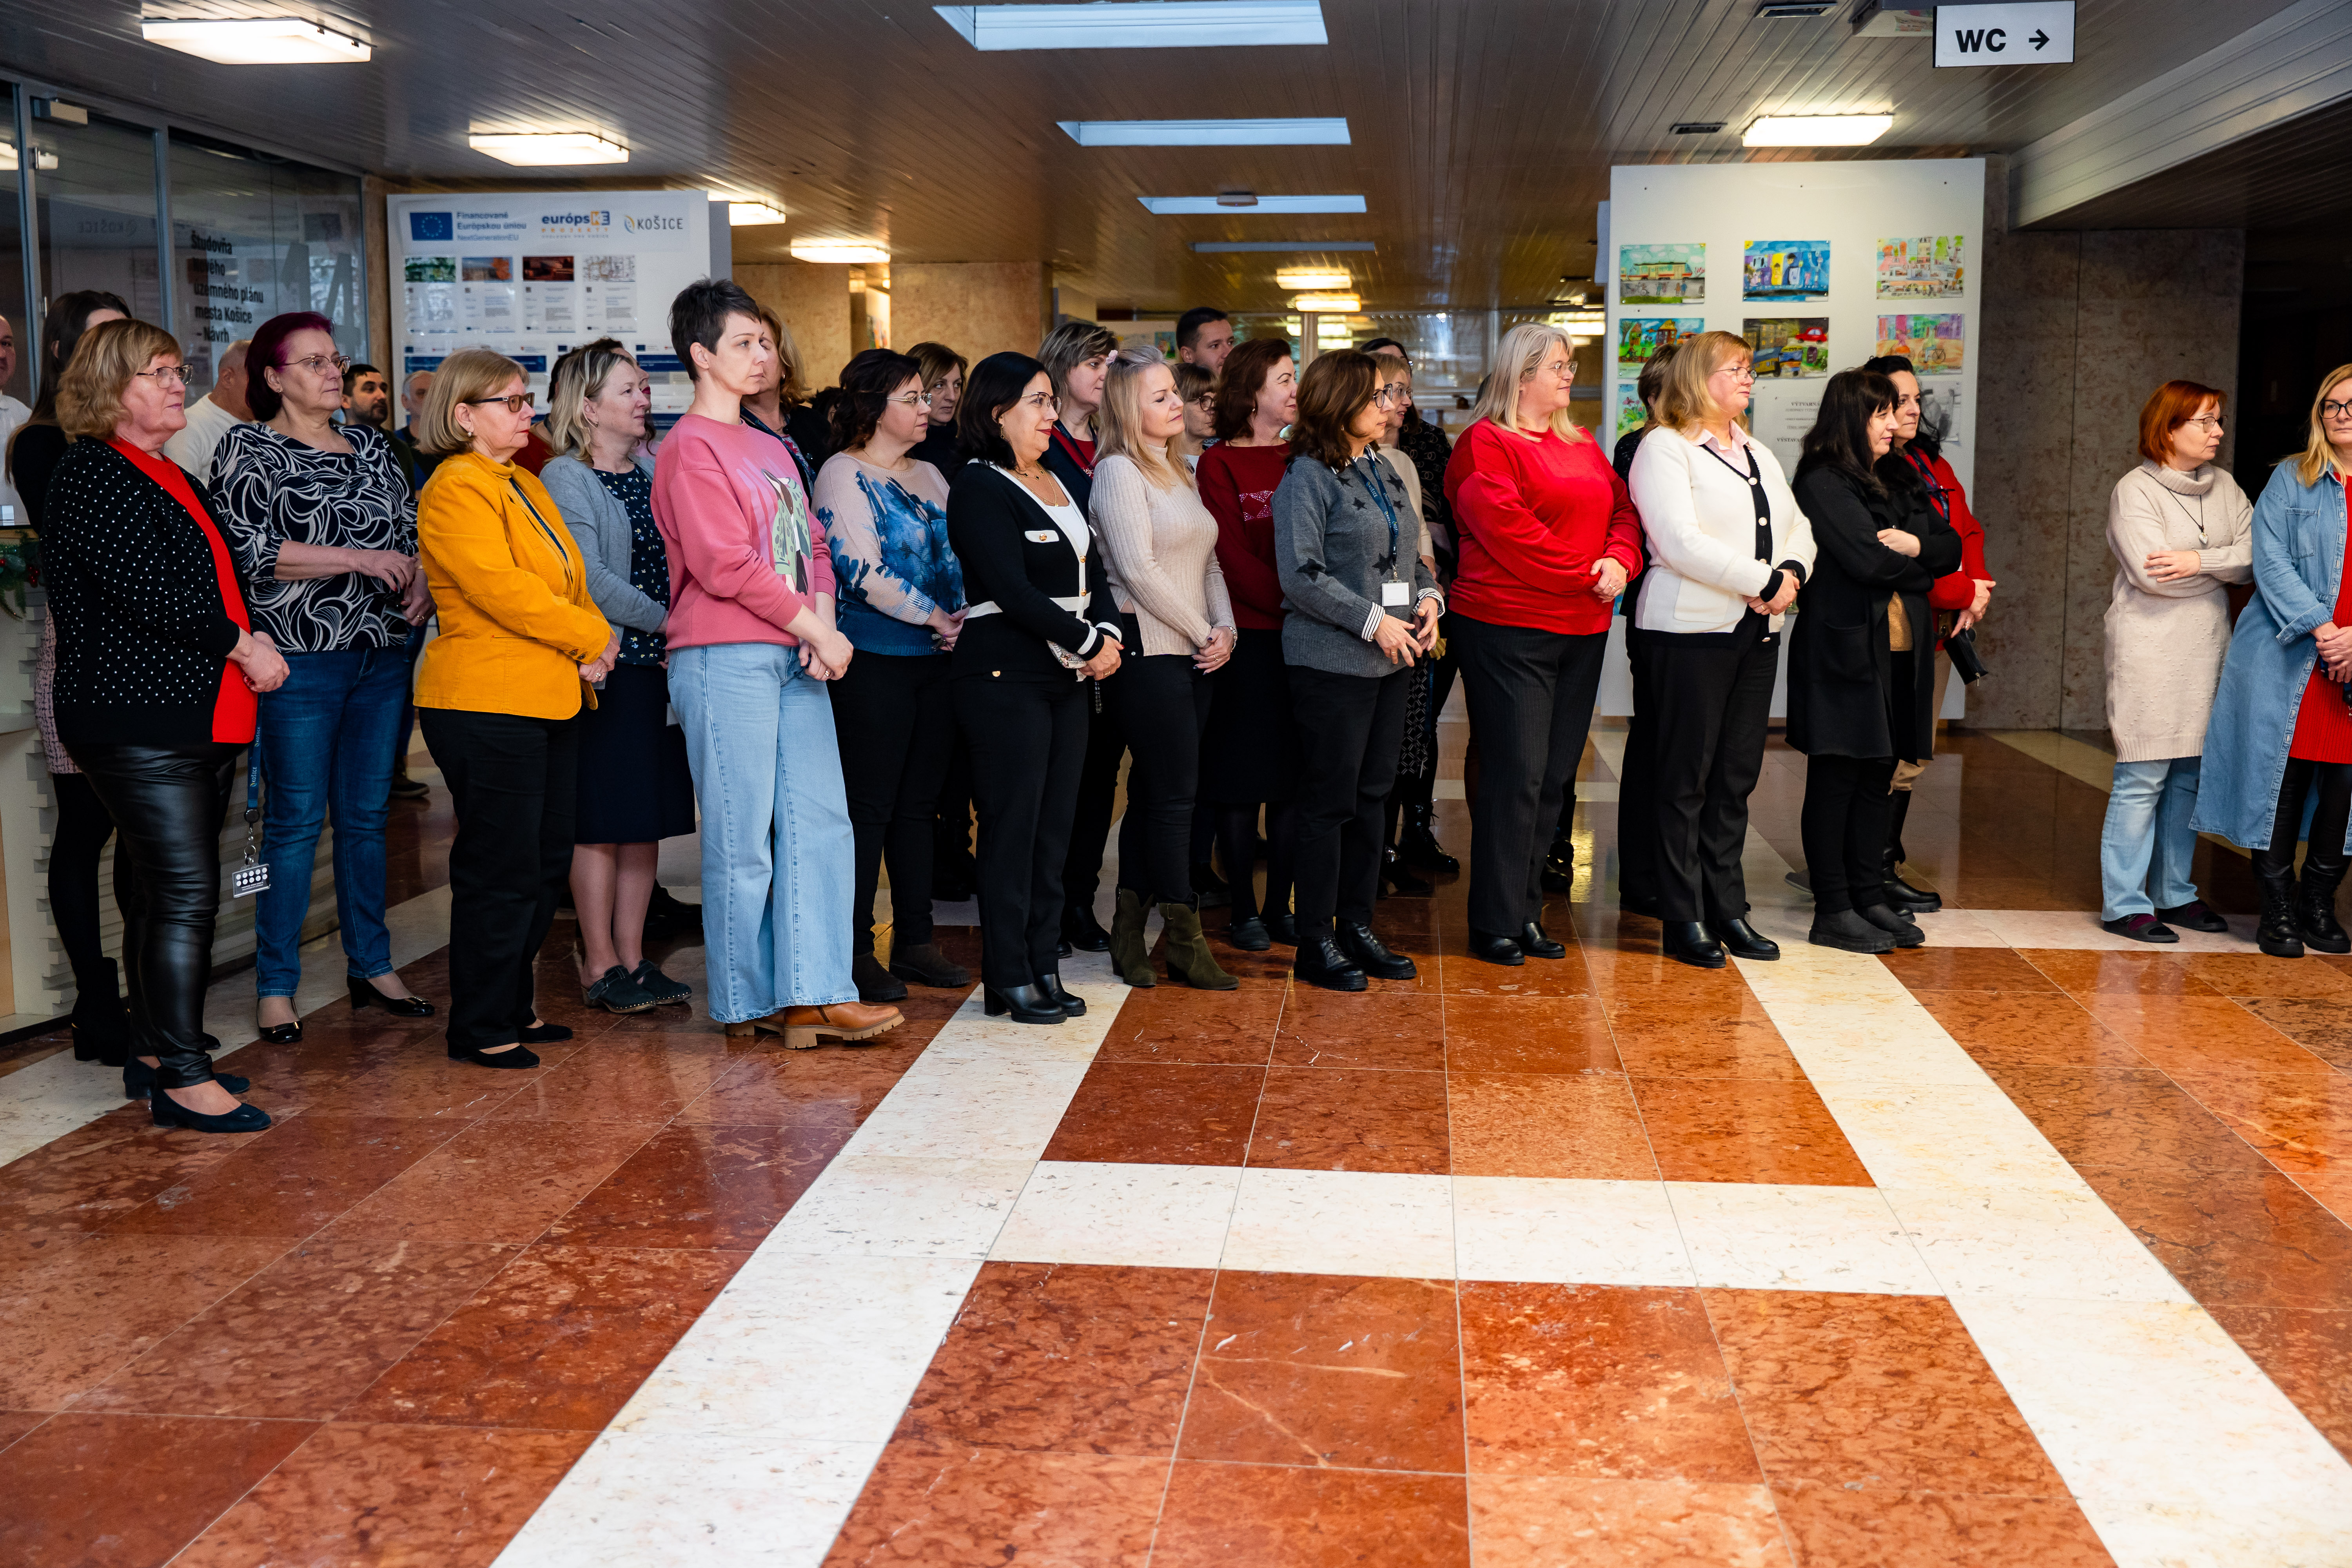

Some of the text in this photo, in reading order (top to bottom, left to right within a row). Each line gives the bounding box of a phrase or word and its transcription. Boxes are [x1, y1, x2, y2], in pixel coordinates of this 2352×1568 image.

[1955, 28, 2006, 53] WC
[457, 222, 501, 230] Európskou
[637, 215, 683, 230] KOŠICE
[191, 230, 232, 255] Študovňa
[194, 278, 264, 304] územného plánu
[195, 306, 253, 324] mesta Košice
[203, 326, 230, 343] Návrh
[1368, 485, 1378, 498] KOŠICE
